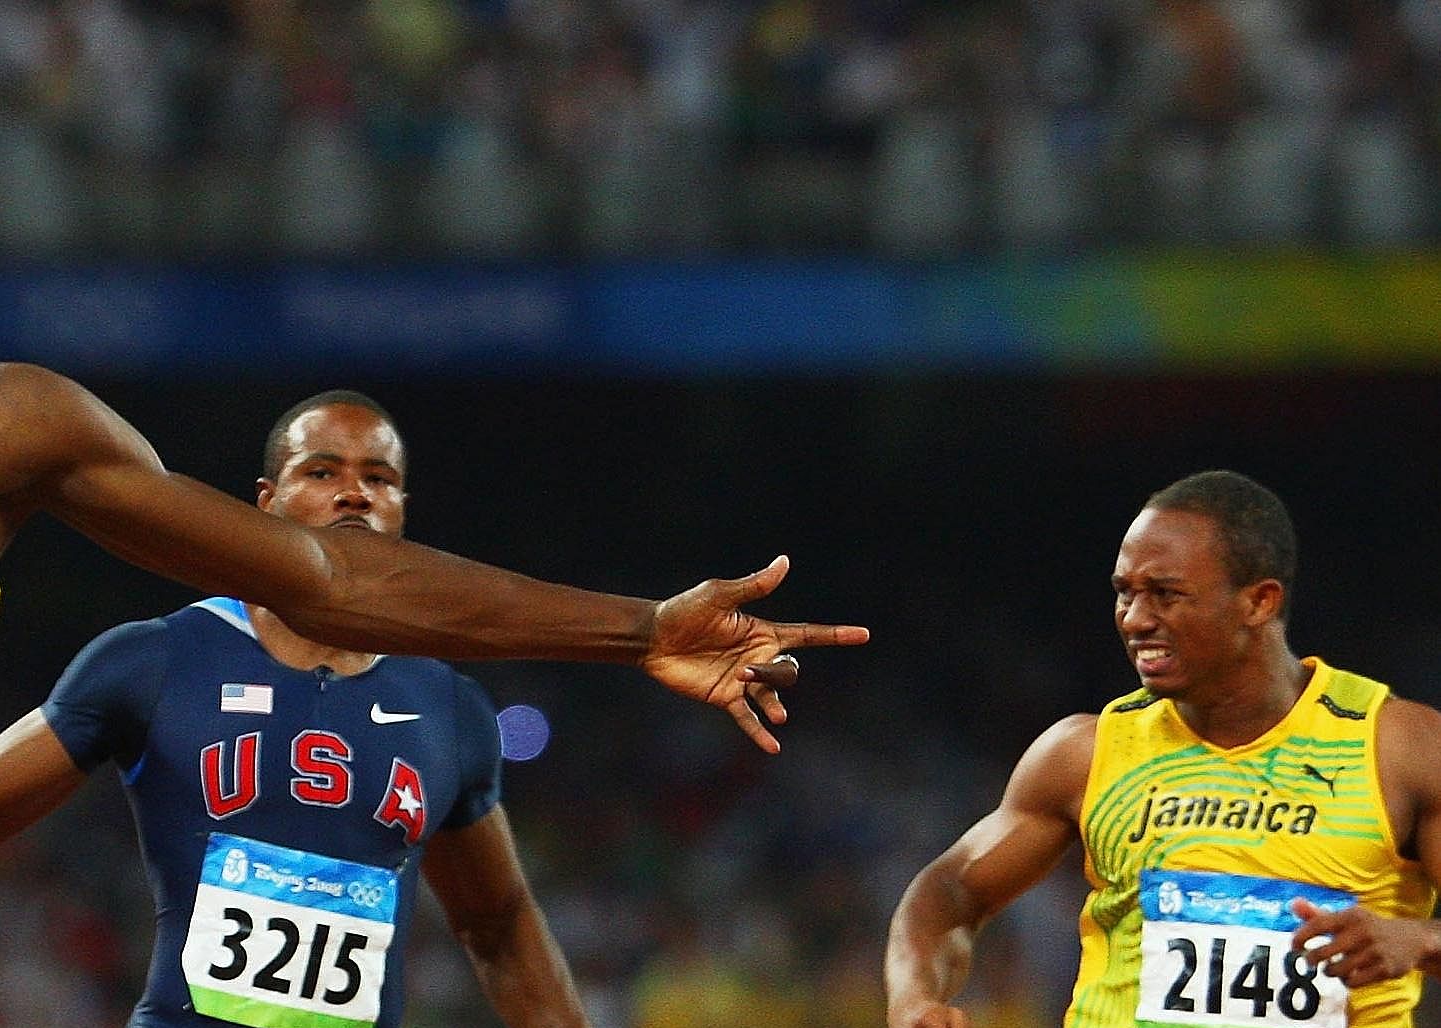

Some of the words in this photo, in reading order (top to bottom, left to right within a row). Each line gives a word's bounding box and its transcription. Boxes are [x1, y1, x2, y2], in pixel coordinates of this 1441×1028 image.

[1128, 786, 1317, 843] jamaica
[207, 907, 368, 1005] 3215
[1163, 937, 1321, 1021] 2148
